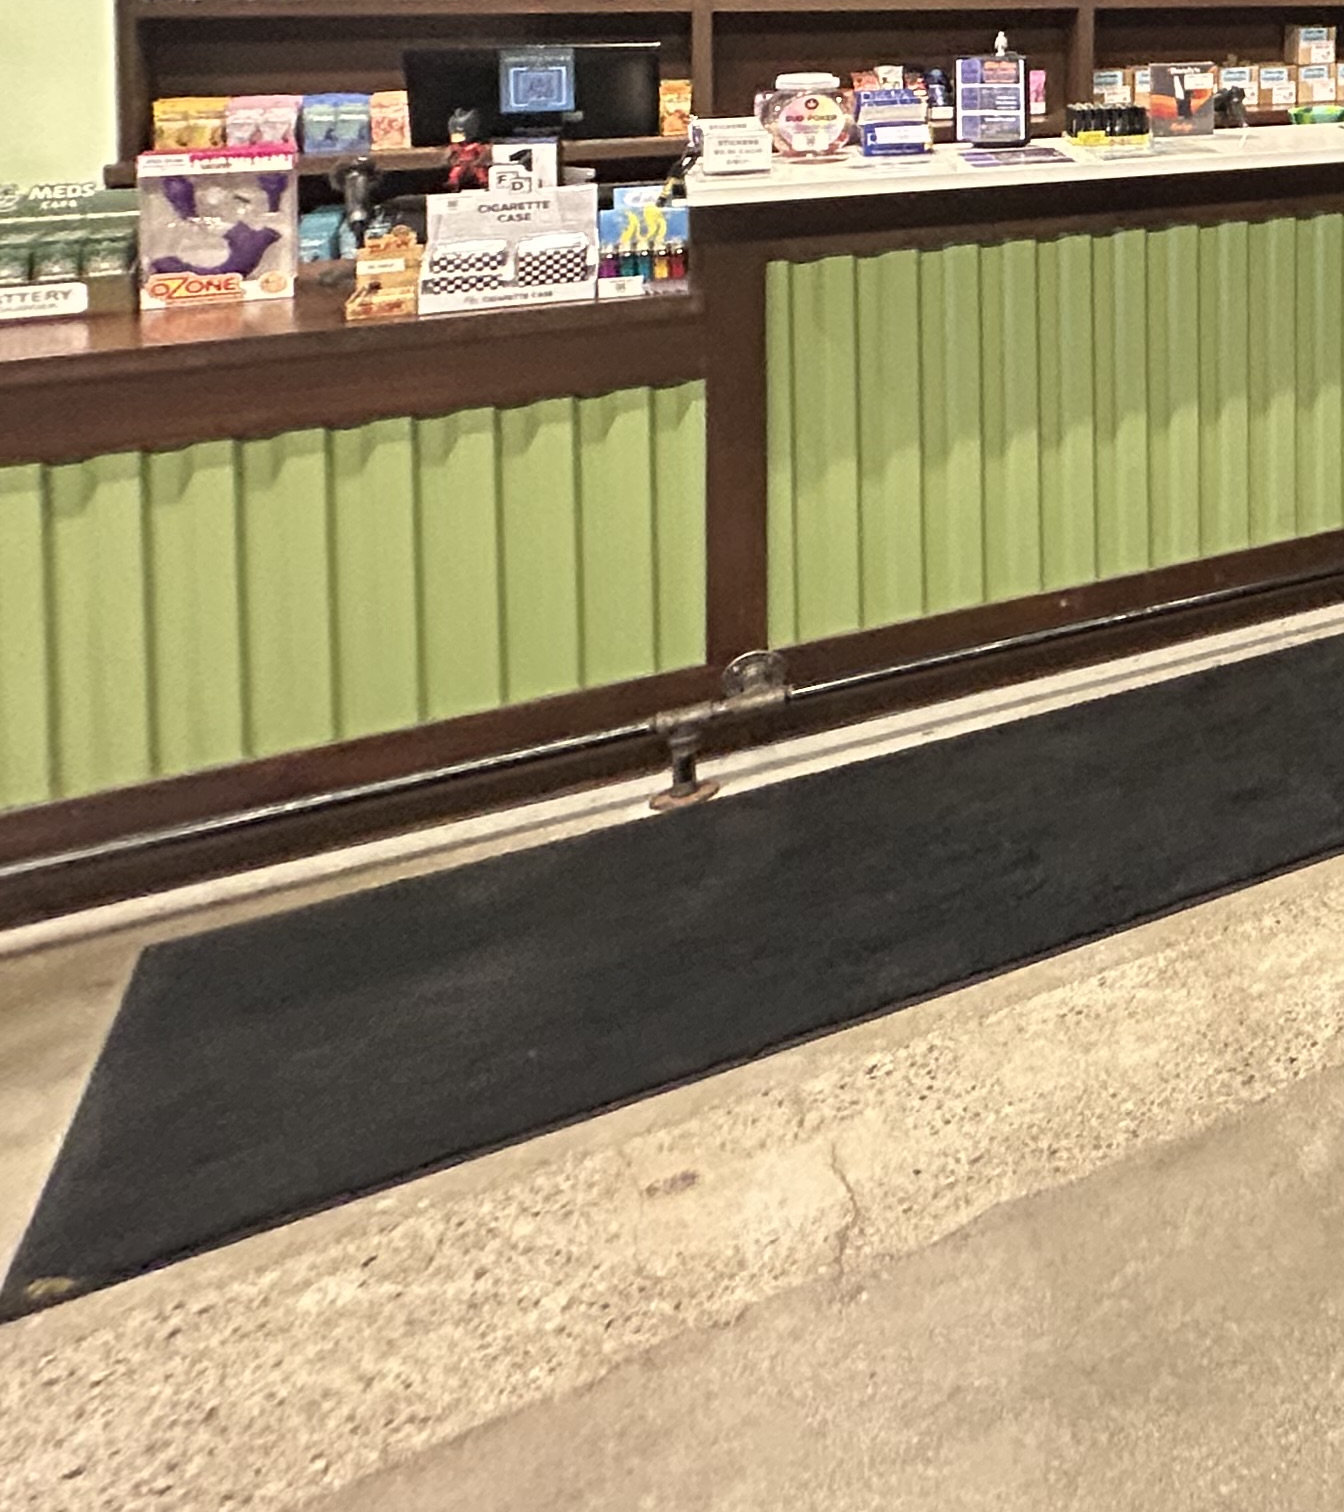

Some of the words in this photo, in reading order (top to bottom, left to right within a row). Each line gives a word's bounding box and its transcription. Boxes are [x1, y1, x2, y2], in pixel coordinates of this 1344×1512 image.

[28, 183, 96, 201] MEDS
[477, 200, 551, 214] CIGARETTE
[497, 213, 532, 223] CASE
[0, 289, 73, 303] TTERY
